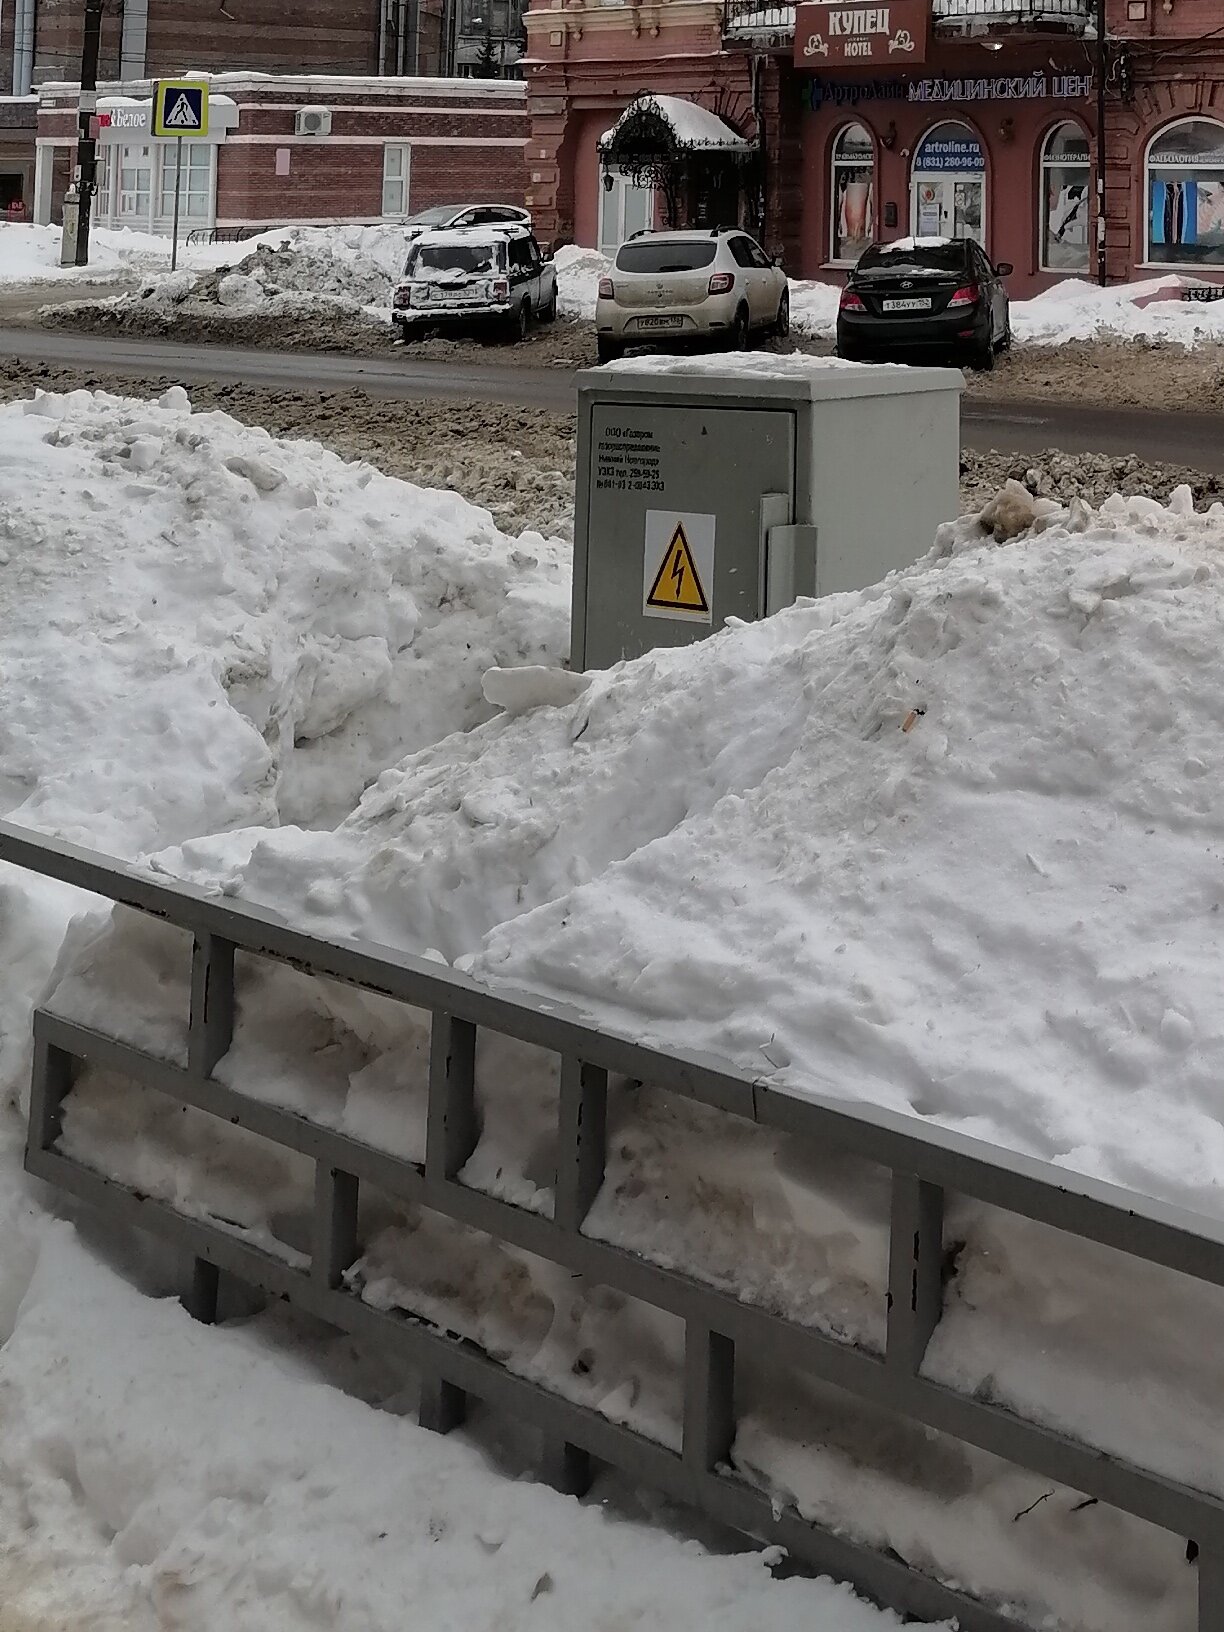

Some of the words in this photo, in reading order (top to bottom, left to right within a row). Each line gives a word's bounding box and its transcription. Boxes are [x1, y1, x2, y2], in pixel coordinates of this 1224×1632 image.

[828, 8, 890, 36] КУПЕЦ
[844, 41, 873, 57] HOTEL
[908, 70, 1047, 101] МЕДИЦИНСКИЙ
[1052, 75, 1092, 98] ЦЕН
[925, 140, 980, 153] artroline.ru
[923, 157, 944, 168] (831)
